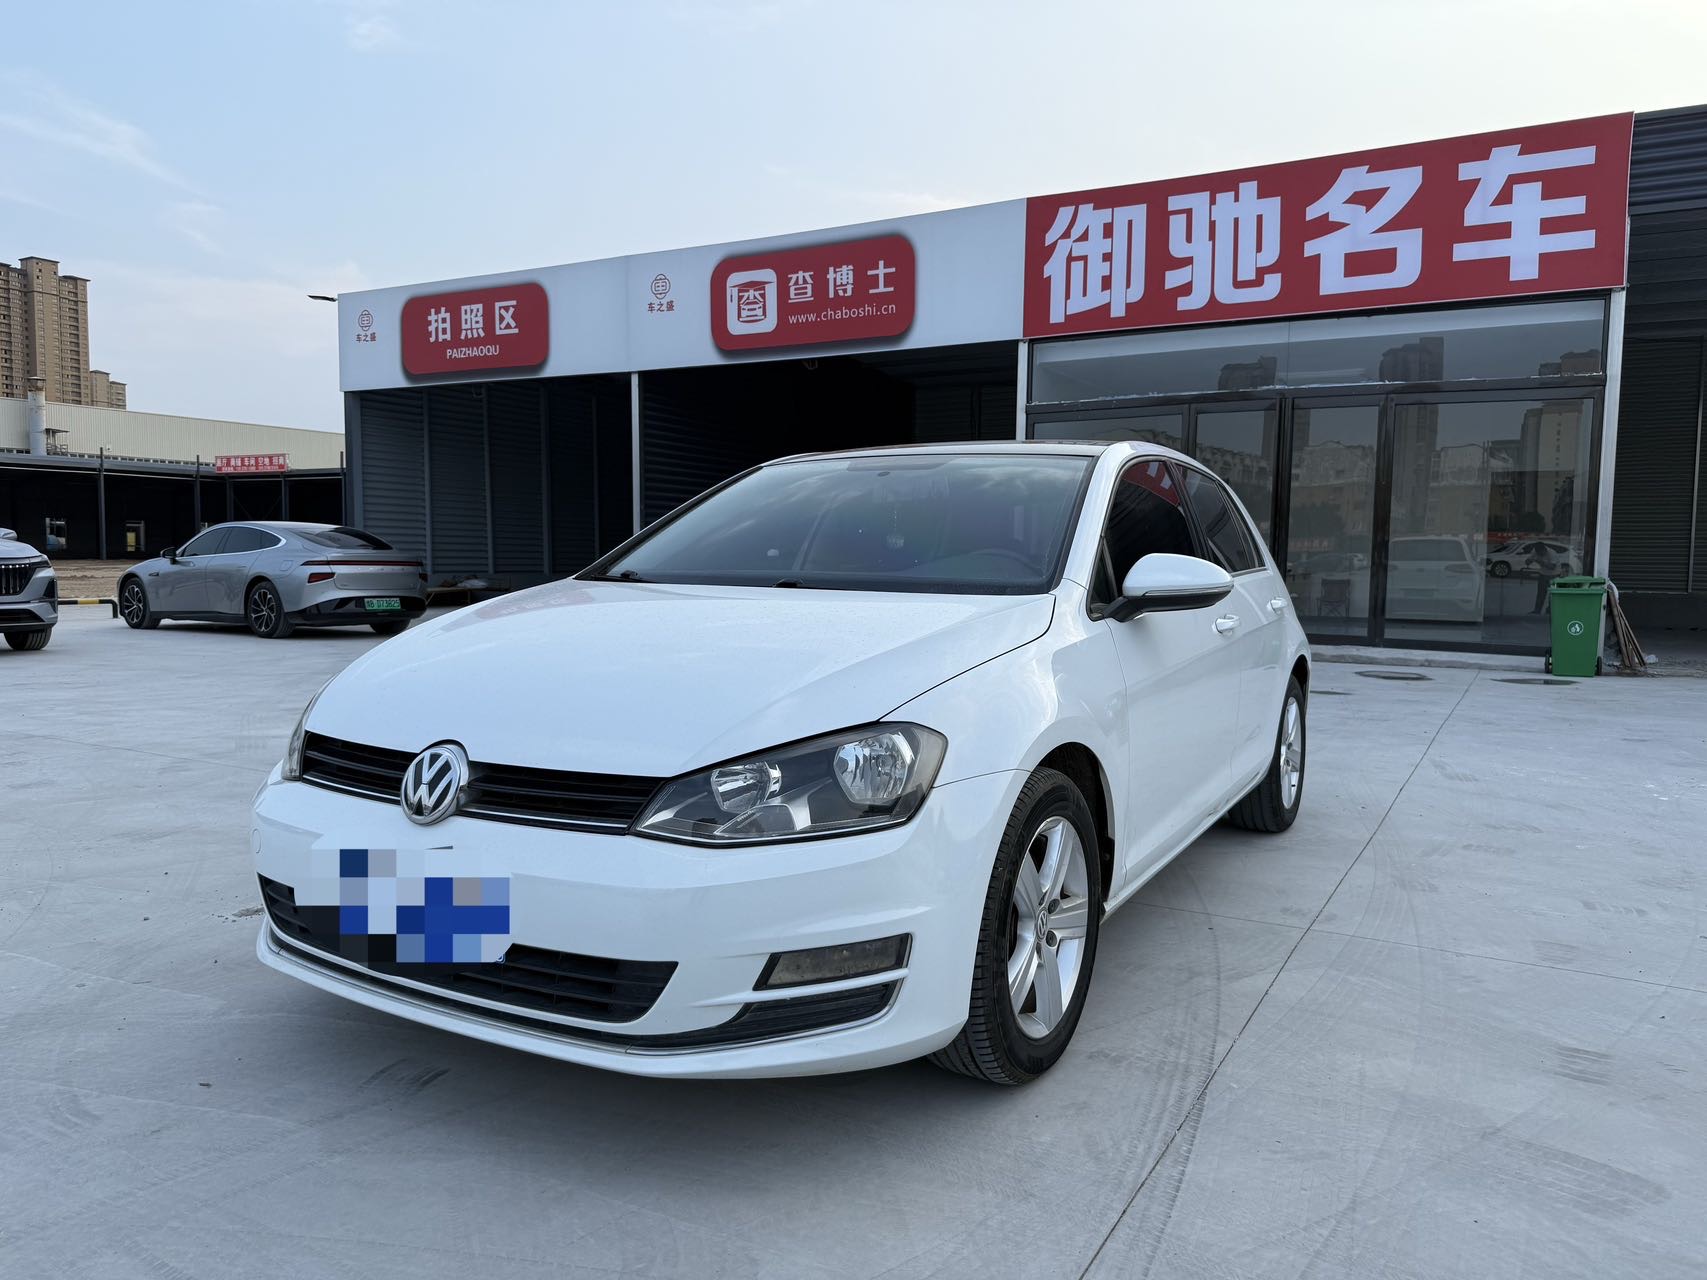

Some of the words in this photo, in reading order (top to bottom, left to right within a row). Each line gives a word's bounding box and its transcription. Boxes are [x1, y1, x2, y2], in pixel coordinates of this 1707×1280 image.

[1043, 143, 1597, 324] 御驰名车
[787, 260, 897, 303] 查博士
[427, 300, 520, 343] 拍照区
[647, 300, 675, 313] 车之盛
[788, 303, 897, 324] www.chaboshi.cn
[446, 344, 500, 359] PAIZHAOQU
